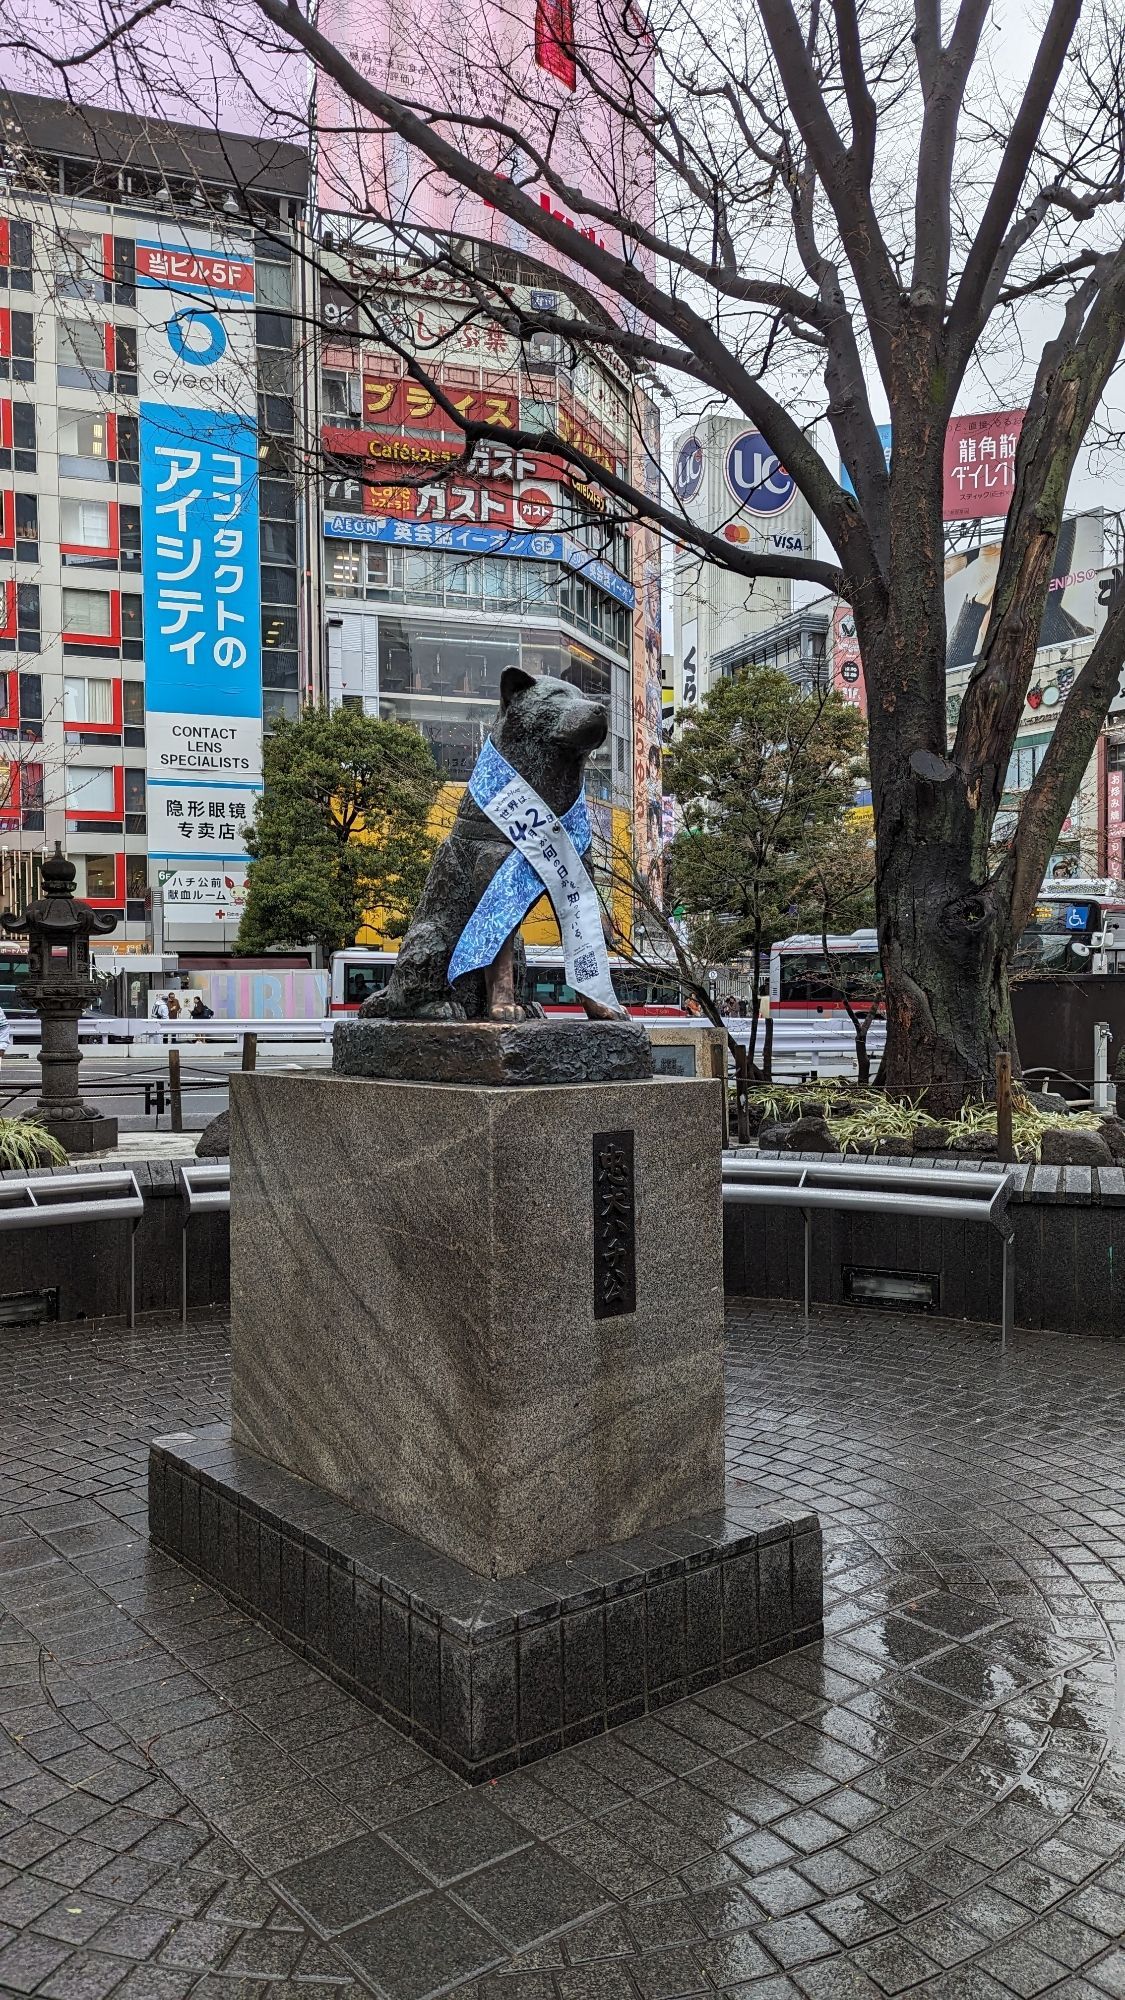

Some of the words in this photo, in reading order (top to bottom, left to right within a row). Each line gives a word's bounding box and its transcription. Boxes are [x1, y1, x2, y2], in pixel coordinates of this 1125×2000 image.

[148, 252, 242, 285] 当ビル5F
[153, 369, 242, 399] eyecity
[959, 433, 1017, 464] 龍角散
[466, 446, 537, 480] ガスト
[734, 449, 791, 495] UC
[416, 481, 505, 523] ガスト
[522, 504, 550, 517] ガスト
[331, 515, 379, 536] AEON
[773, 534, 803, 551] VISA
[154, 446, 206, 665] アイシティ
[212, 453, 247, 668] コンタクトの
[172, 725, 237, 740] CONTACT
[187, 740, 222, 753] LENS
[160, 754, 249, 768] SPECIALISTS
[166, 799, 247, 819] 隐形眼镜
[177, 821, 236, 841] 专卖店
[159, 871, 171, 880] 6F
[172, 877, 221, 888] ハチ公前
[168, 889, 226, 900] 献血ルーム
[599, 1142, 631, 1304] 忠犬ハチ公
